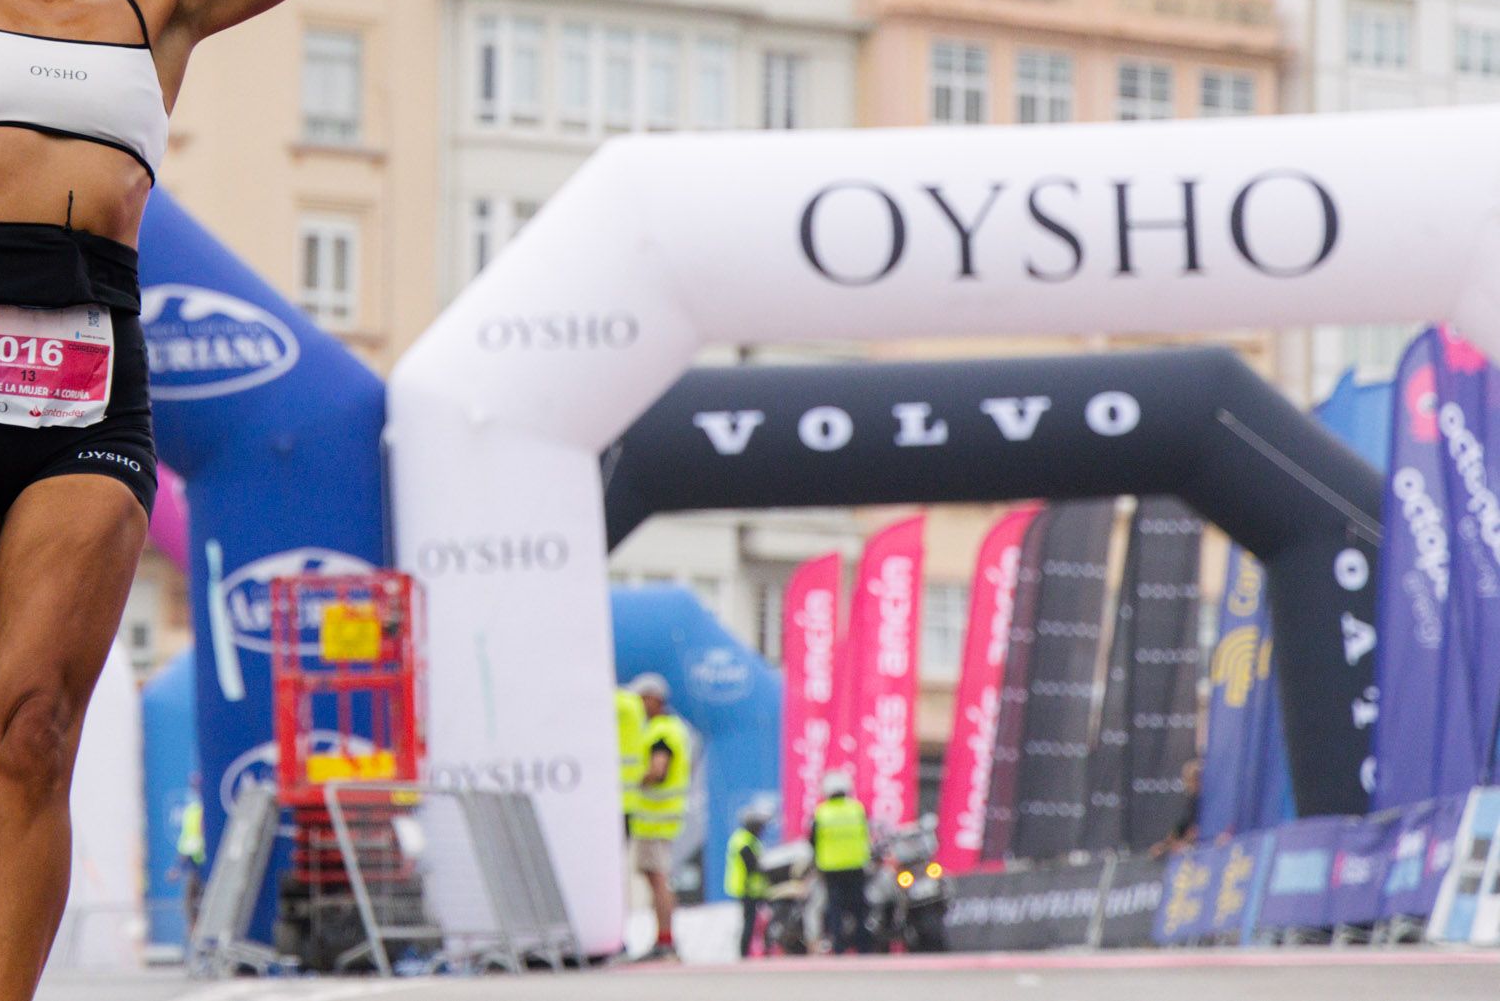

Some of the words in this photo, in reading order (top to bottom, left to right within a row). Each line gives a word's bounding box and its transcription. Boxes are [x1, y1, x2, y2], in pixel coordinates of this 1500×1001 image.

[29, 65, 88, 81] OYSHO
[798, 169, 1343, 288] OYSHO
[476, 314, 641, 351] OYSHO
[5, 383, 17, 393] LA
[18, 384, 49, 396] MUJER
[21, 369, 36, 382] 13
[694, 391, 1142, 456] VOLVO
[417, 534, 571, 578] OYSHO
